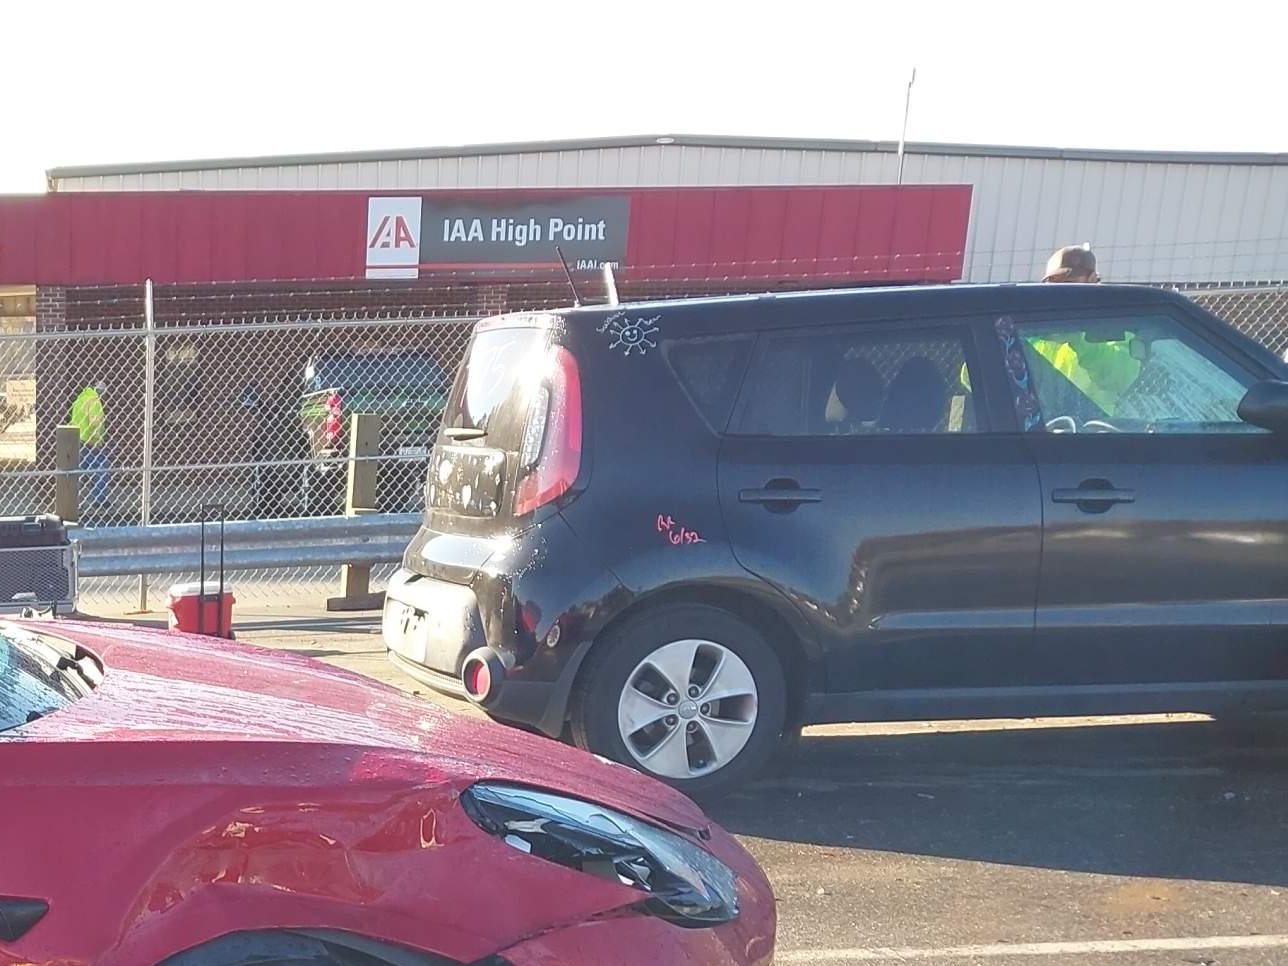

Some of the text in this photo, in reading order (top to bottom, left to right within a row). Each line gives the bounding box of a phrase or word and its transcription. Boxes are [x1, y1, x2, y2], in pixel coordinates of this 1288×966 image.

[443, 217, 607, 247] IAA High Point
[576, 259, 619, 271] IAAI.cm
